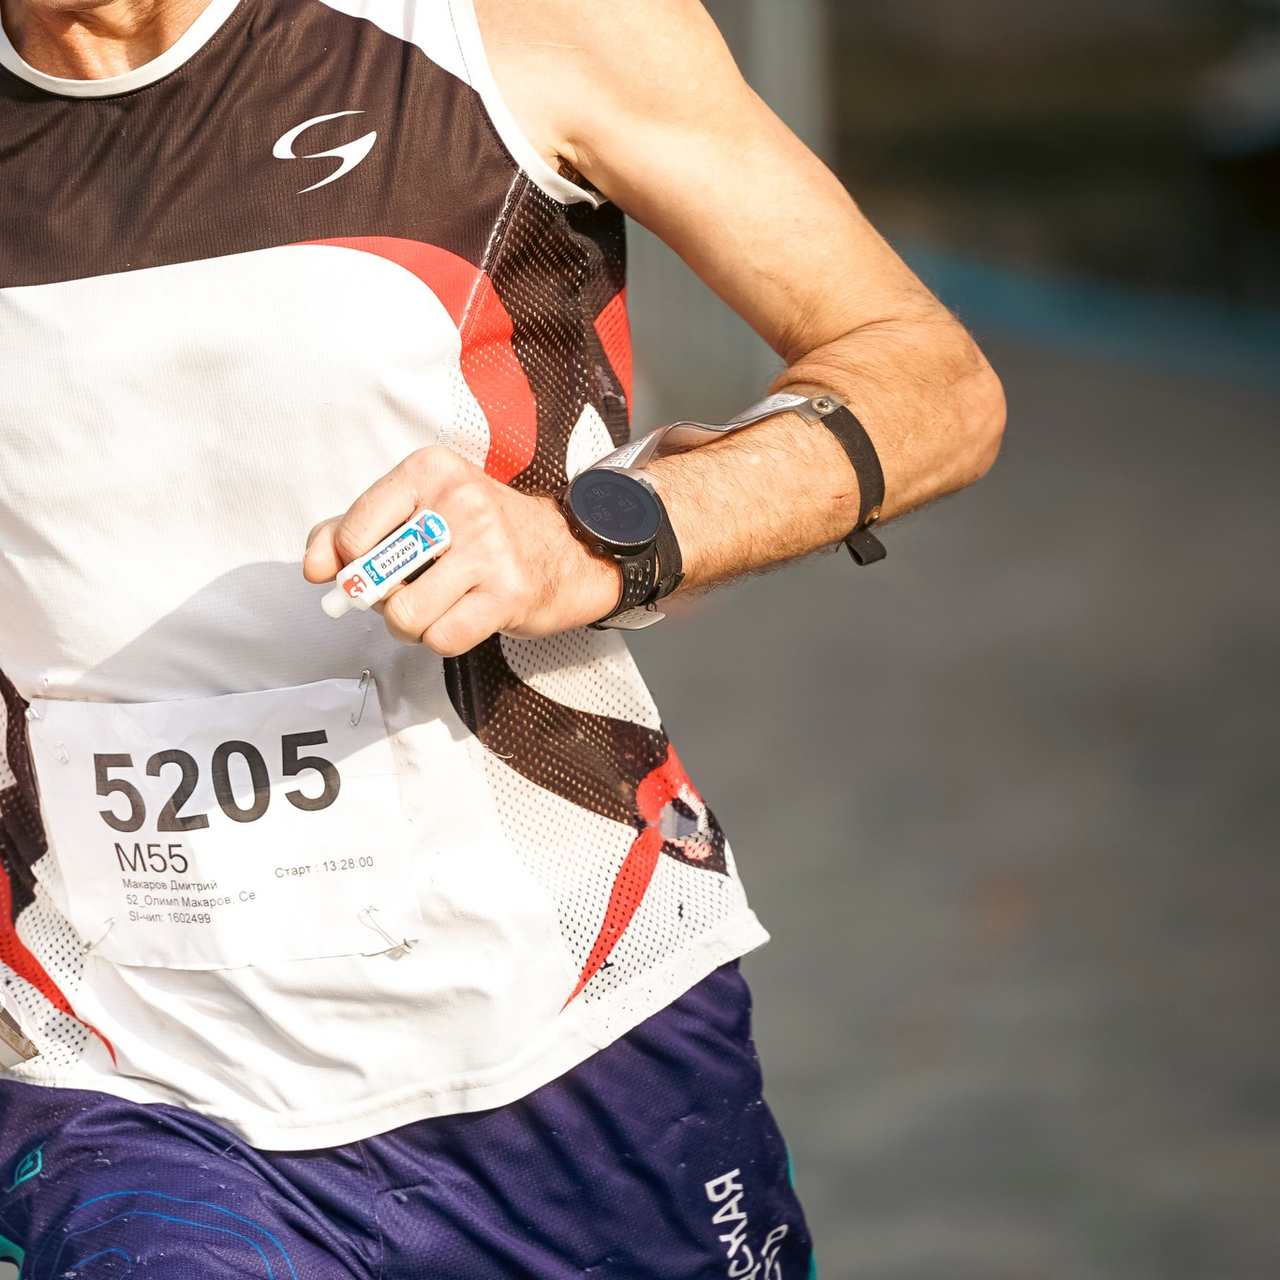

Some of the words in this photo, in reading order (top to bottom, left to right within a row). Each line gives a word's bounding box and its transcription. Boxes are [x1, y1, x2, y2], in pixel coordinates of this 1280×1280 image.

[380, 541, 416, 570] 8372269
[93, 729, 341, 833] 5205
[274, 865, 311, 879] Старт
[322, 855, 374, 872] 13:28:00
[122, 878, 168, 891] Макаров
[170, 879, 218, 893] Дмитрий
[126, 894, 180, 908] 52_Олимп
[167, 912, 212, 924] 1602499
